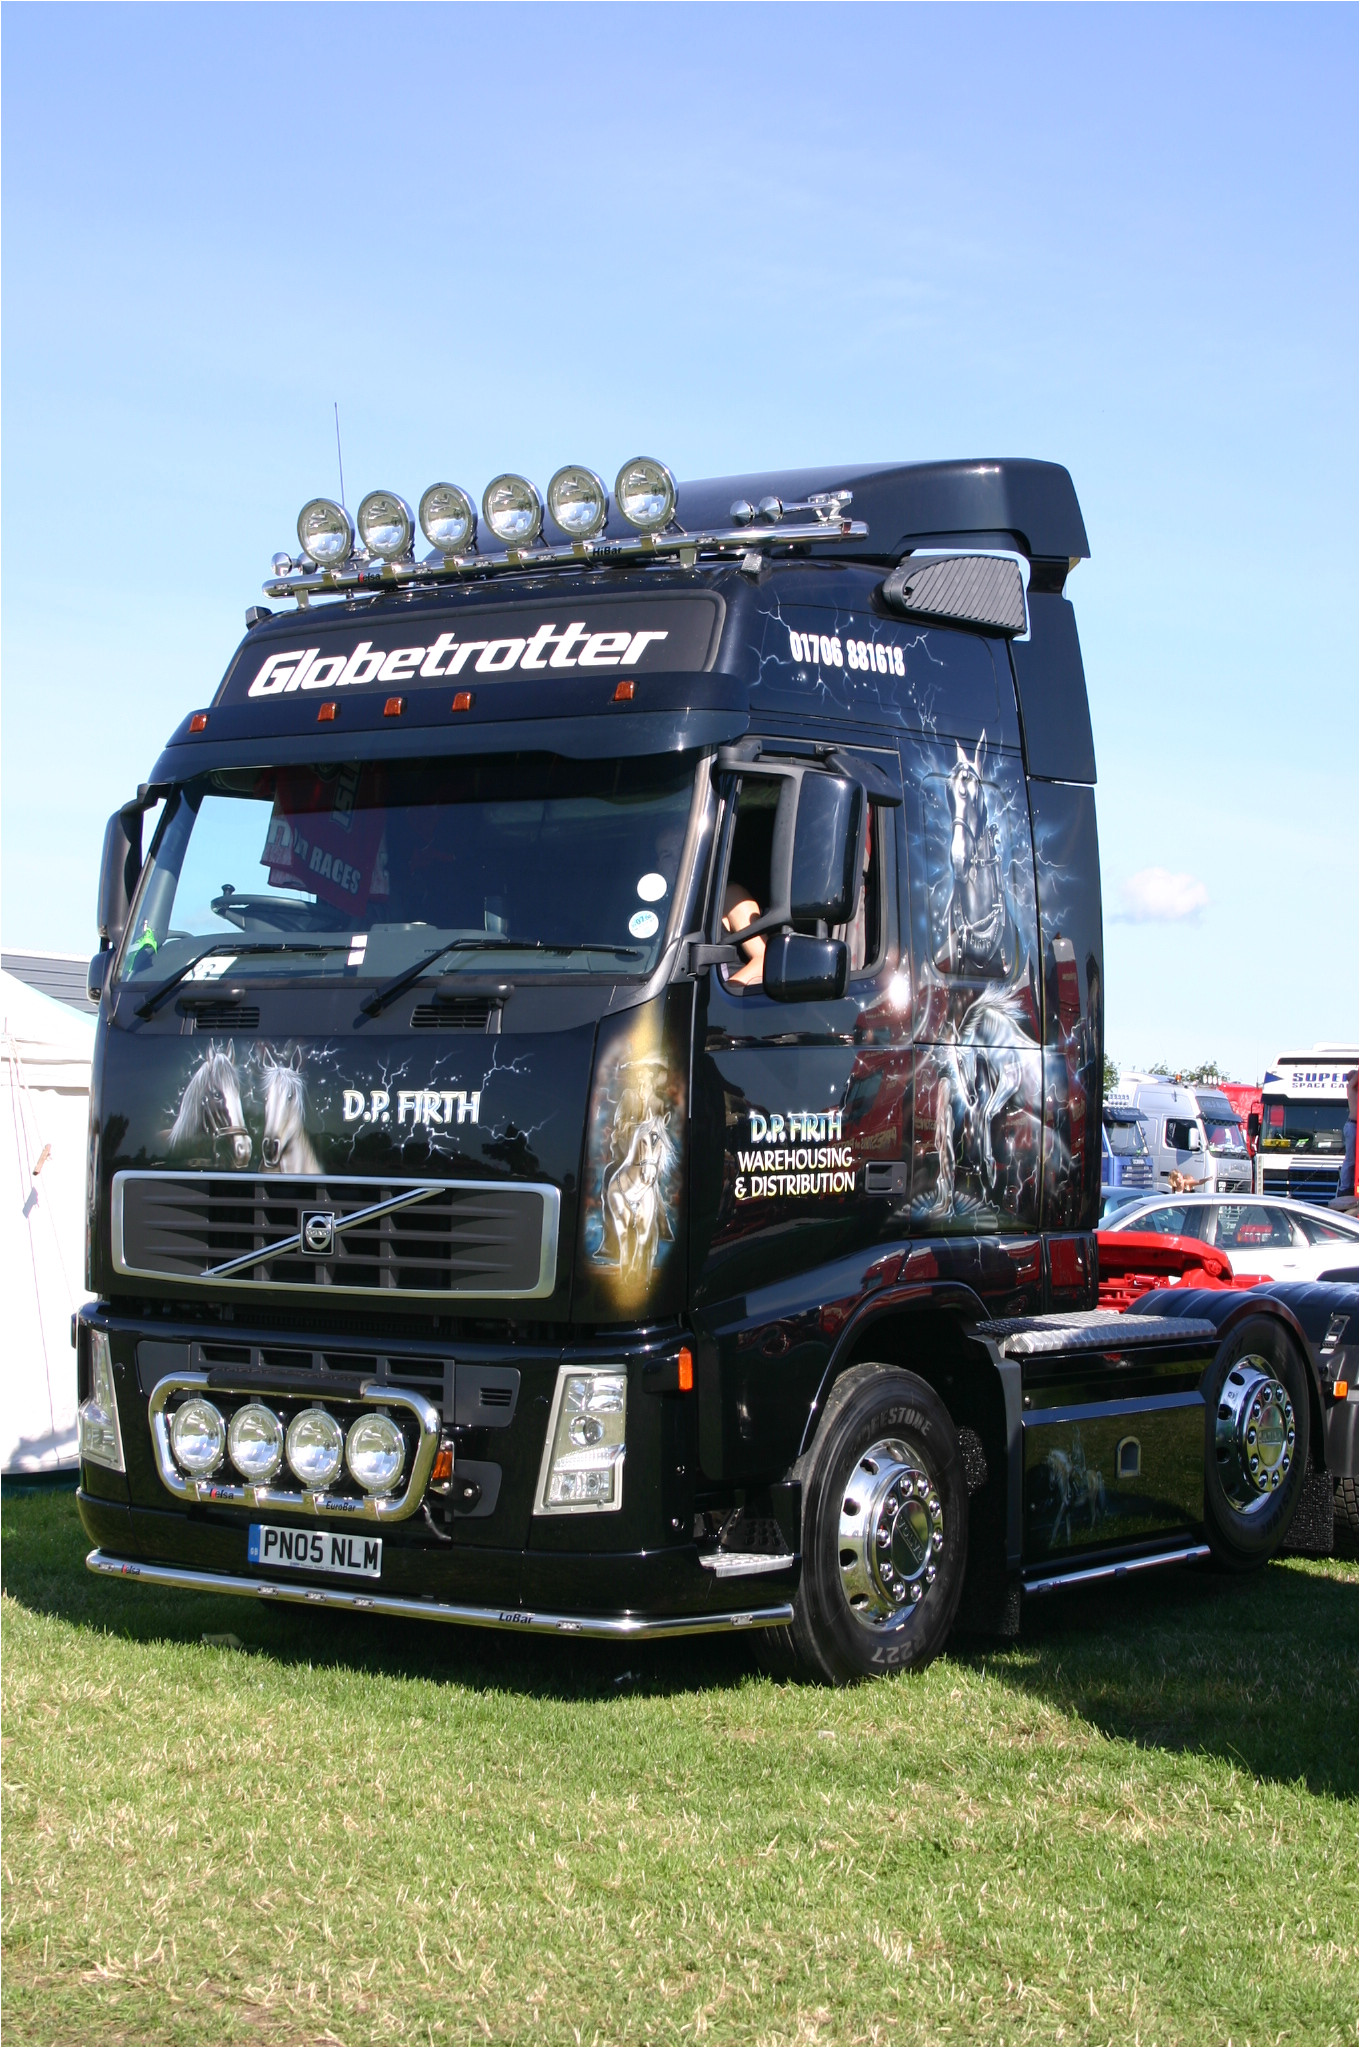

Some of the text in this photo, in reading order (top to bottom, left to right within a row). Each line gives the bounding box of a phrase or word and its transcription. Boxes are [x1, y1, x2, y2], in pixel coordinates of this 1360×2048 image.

[248, 621, 669, 698] Globetrotter
[789, 631, 905, 676] 01706 881618
[309, 846, 361, 895] RACES
[342, 1089, 482, 1125] D.P. FIRTH
[749, 1111, 787, 1143] D.P.
[788, 1110, 843, 1143] FIRTH
[737, 1146, 853, 1172] WAREHOUSING
[734, 1171, 855, 1199] & DISTRIBUTION
[325, 1500, 356, 1512] EuroBar
[264, 1529, 324, 1564] PN05
[330, 1537, 379, 1571] NLM
[498, 1611, 534, 1625] LoBar
